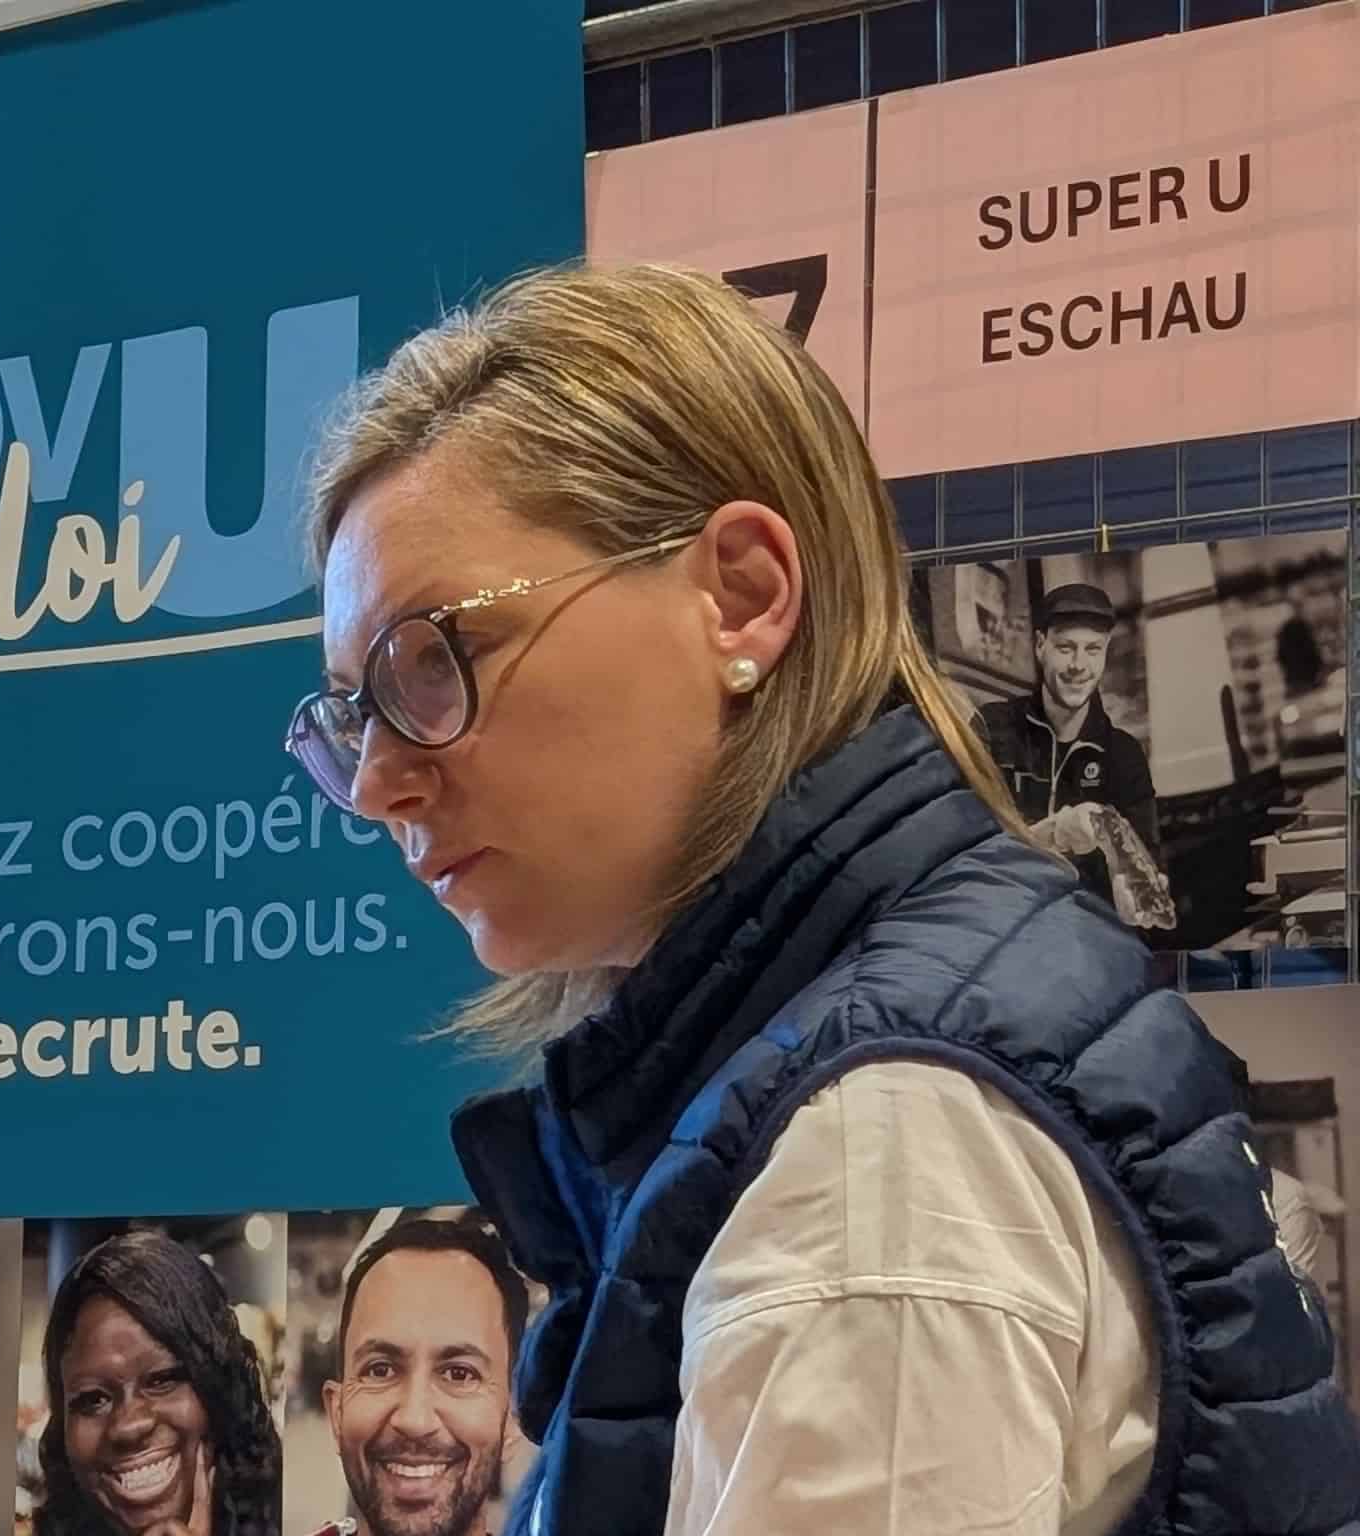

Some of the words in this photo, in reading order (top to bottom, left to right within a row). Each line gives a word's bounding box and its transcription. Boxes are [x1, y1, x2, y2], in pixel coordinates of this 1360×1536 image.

[978, 166, 1188, 252] SUPER
[1209, 154, 1251, 212] U
[981, 272, 1248, 364] ESCHAU
[120, 295, 360, 618] U
